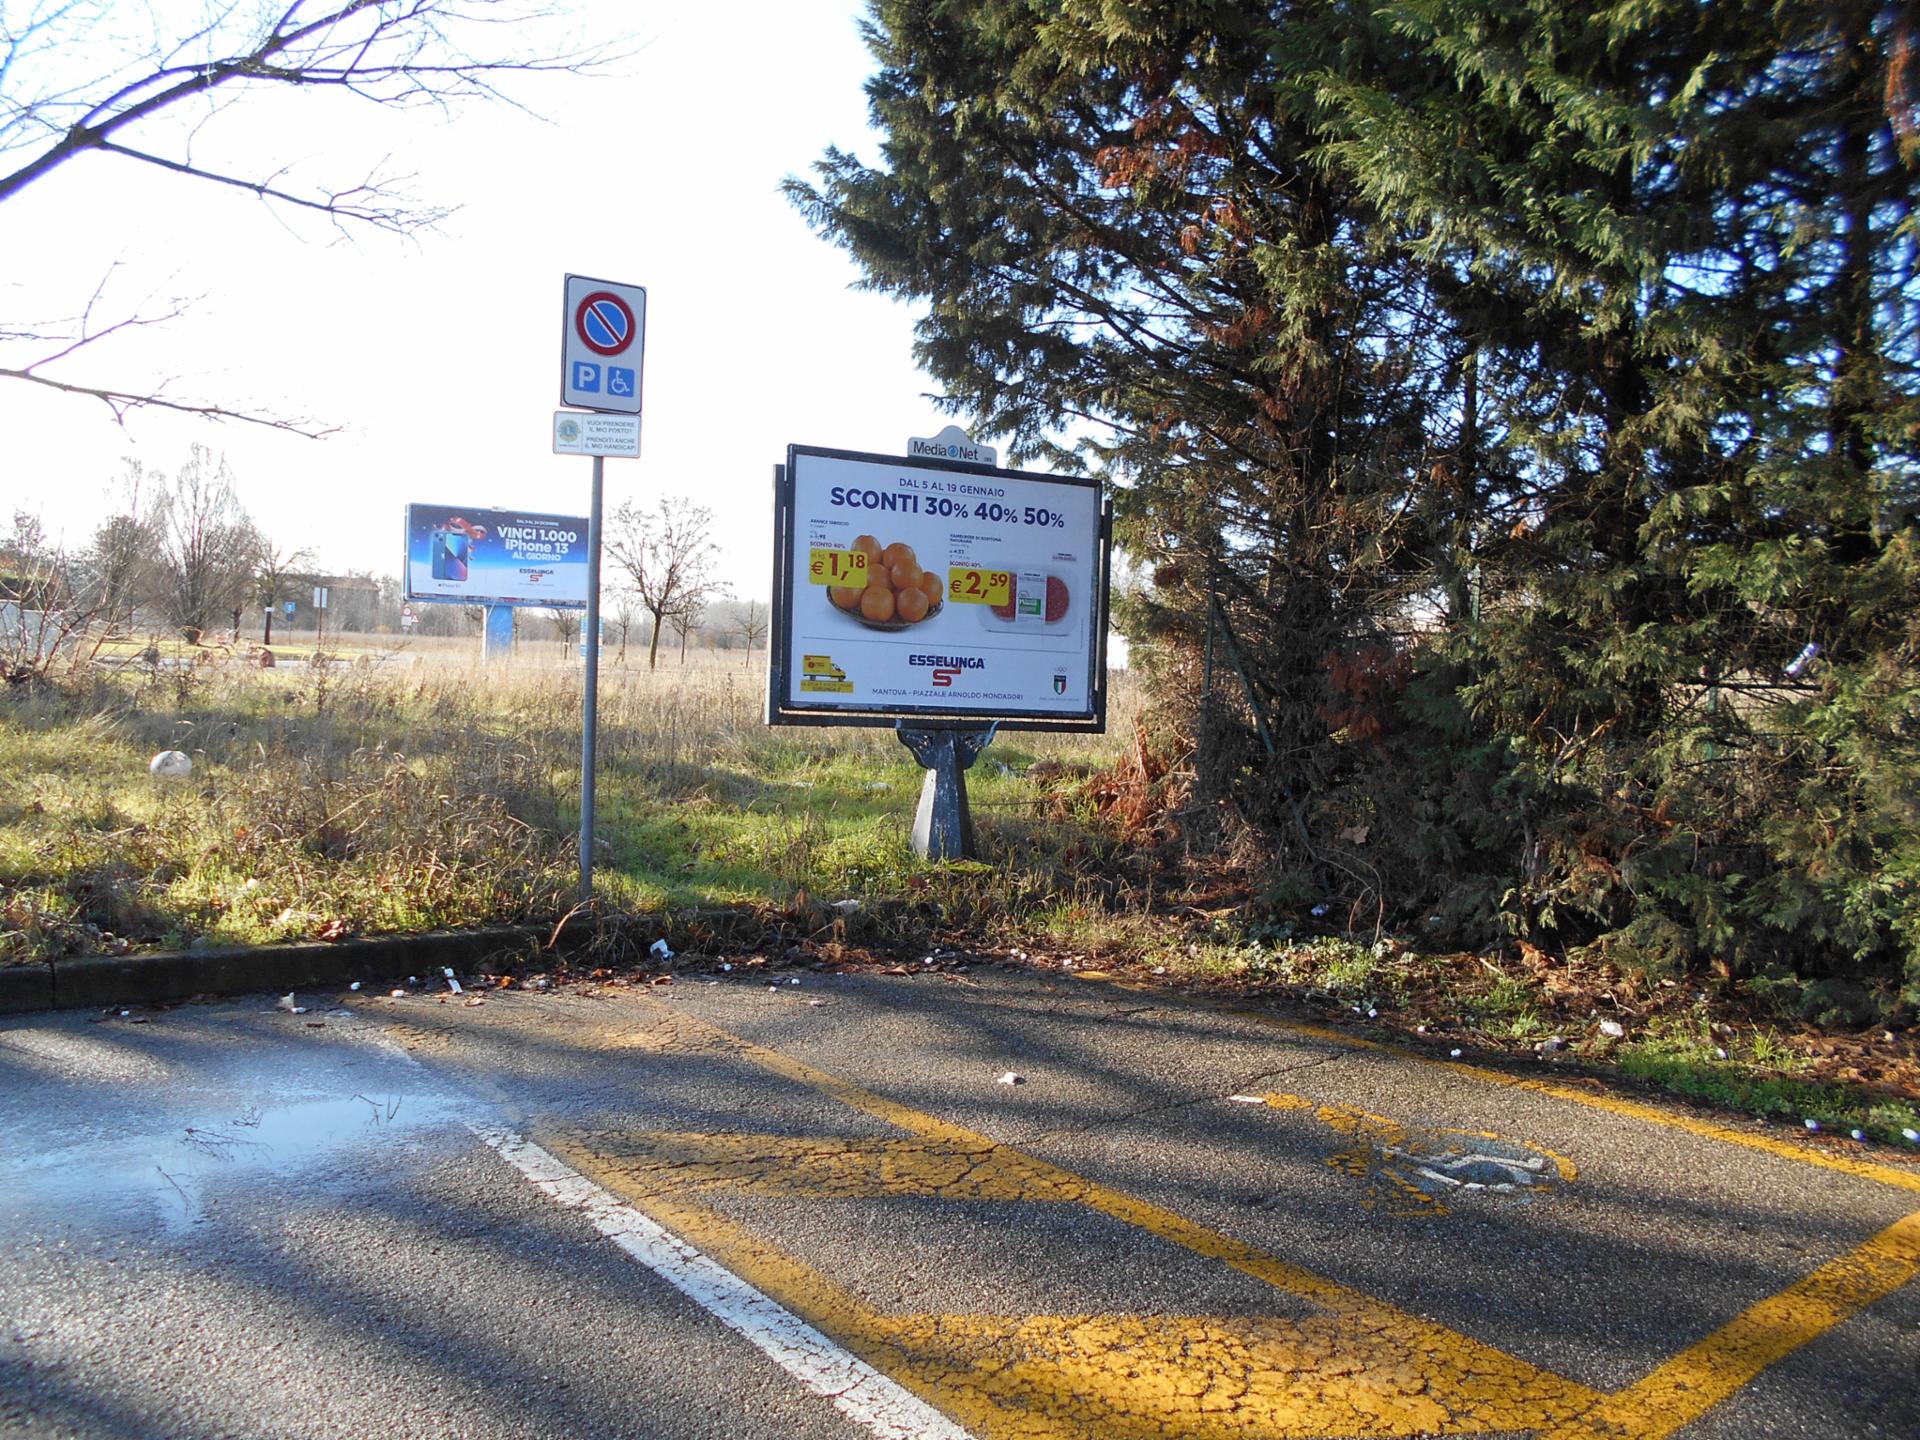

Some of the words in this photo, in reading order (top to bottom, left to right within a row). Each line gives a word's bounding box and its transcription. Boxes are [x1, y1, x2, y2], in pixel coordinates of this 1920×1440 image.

[579, 365, 596, 388] P
[913, 441, 947, 457] Media
[959, 446, 978, 461] Net
[899, 478, 919, 488] DAL
[922, 480, 928, 489] 5
[931, 481, 944, 491] AL
[947, 483, 957, 492] 19
[960, 485, 1005, 497] GENNAIO
[830, 487, 918, 514] SCONTI
[925, 496, 968, 519] 30%
[974, 502, 1018, 524] 40%
[1023, 507, 1064, 528] 50%
[497, 526, 536, 540] VINCI
[540, 529, 577, 543] 1.000
[505, 538, 552, 553] iPhone
[555, 543, 569, 554] 13
[512, 551, 525, 560] AL
[526, 552, 562, 561] GIORNO
[909, 654, 985, 669] ESSELUNGA
[872, 688, 907, 696] MANTOVA
[913, 689, 946, 698] PIAZZALE
[949, 690, 981, 699] ARNOLDO
